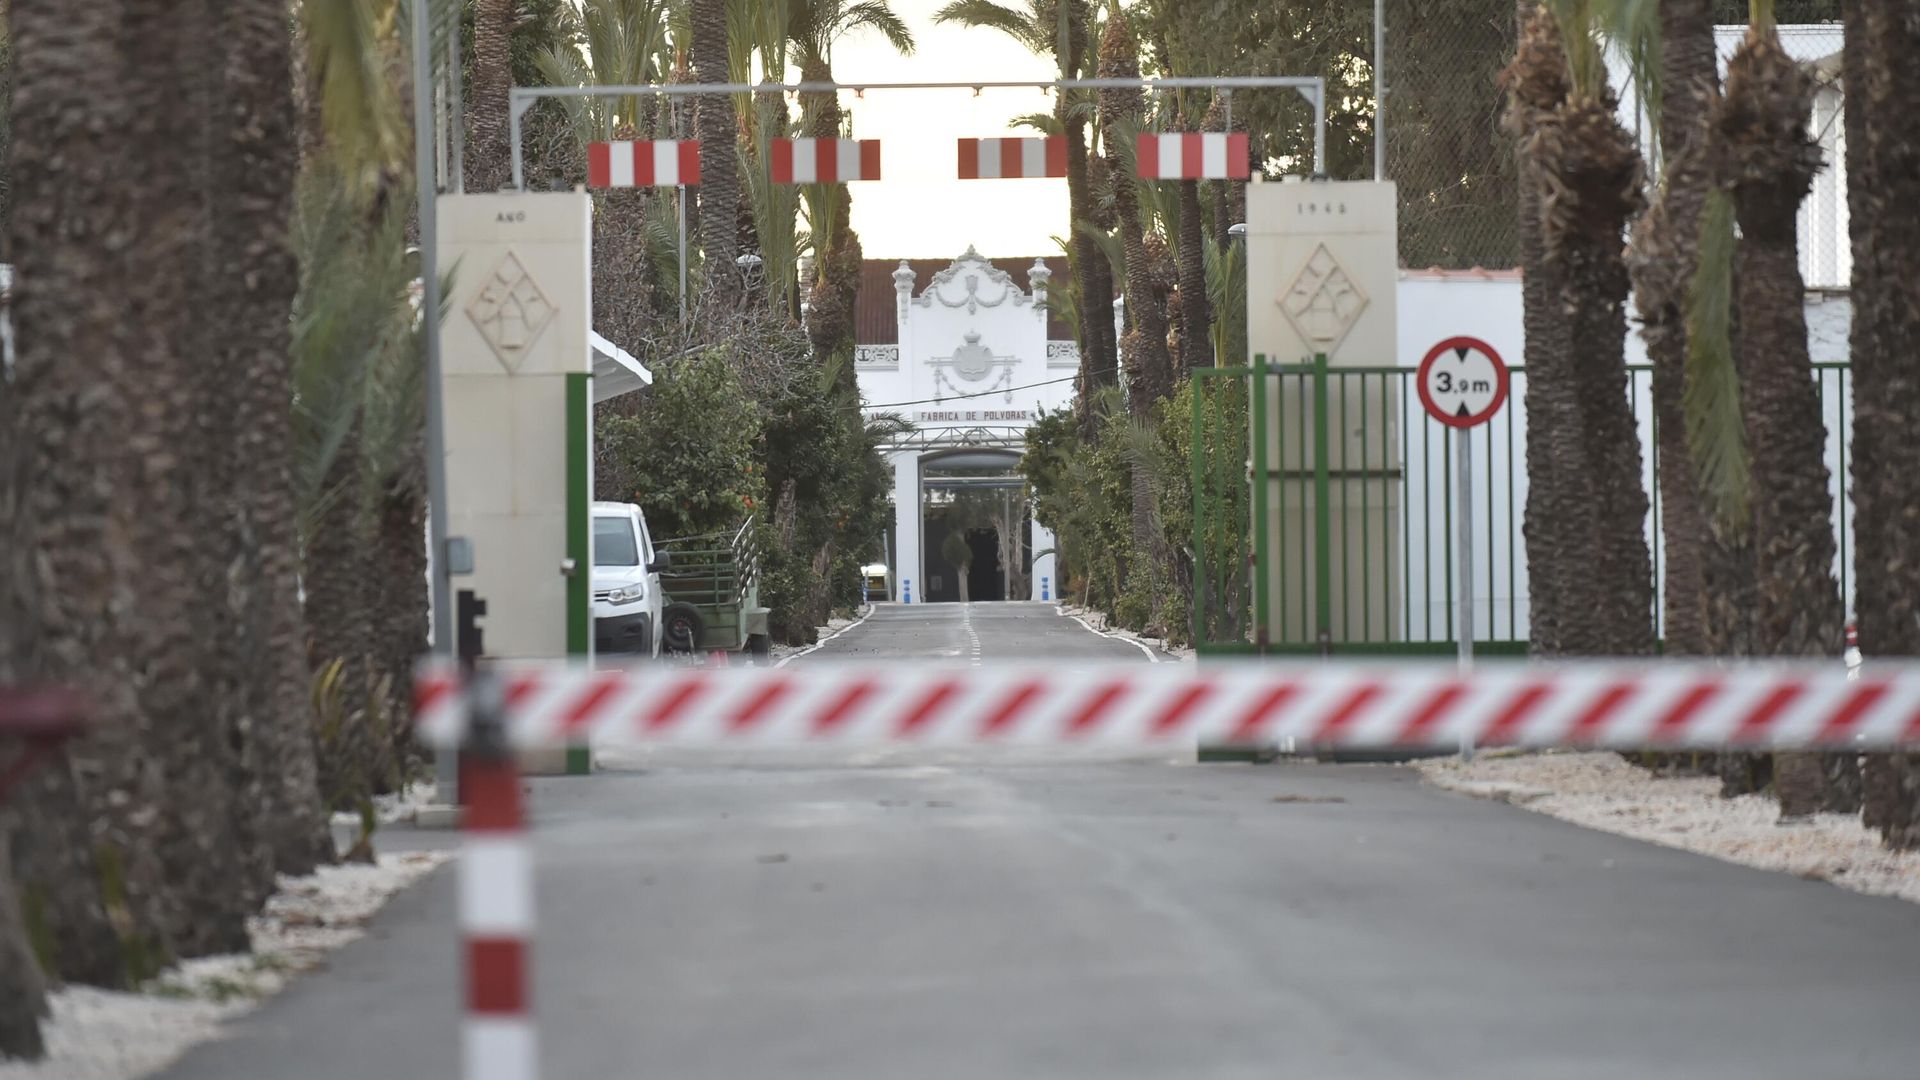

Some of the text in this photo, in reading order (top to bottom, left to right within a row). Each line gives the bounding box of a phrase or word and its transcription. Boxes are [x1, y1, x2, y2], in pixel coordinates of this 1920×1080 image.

[921, 410, 1027, 421] FABRICA DE POLVORAS
